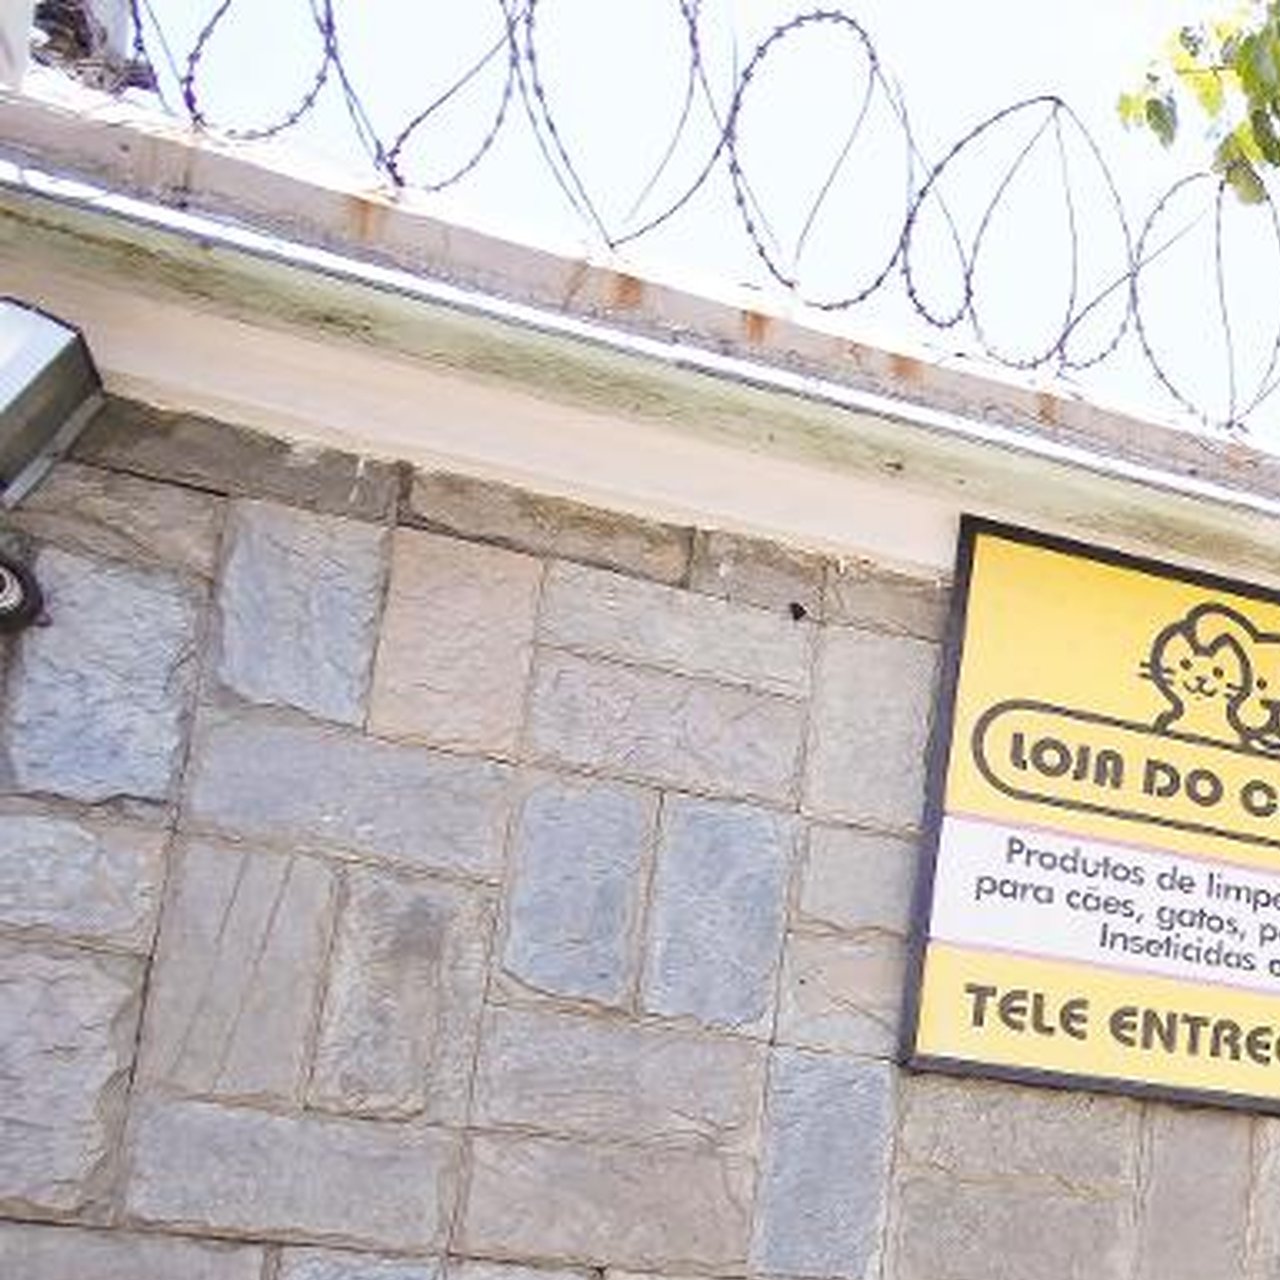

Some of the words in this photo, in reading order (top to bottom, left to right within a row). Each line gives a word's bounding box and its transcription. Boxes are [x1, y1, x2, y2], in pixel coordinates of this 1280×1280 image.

[1010, 732, 1124, 789] LOJA
[1142, 758, 1224, 807] DO
[1005, 835, 1145, 886] Produtos
[1156, 865, 1196, 894] de
[974, 874, 1054, 902] para
[1065, 884, 1145, 924] cães,
[1156, 904, 1246, 941] gatos,
[1099, 922, 1257, 972] Inseticidas
[964, 982, 1089, 1041] TELE
